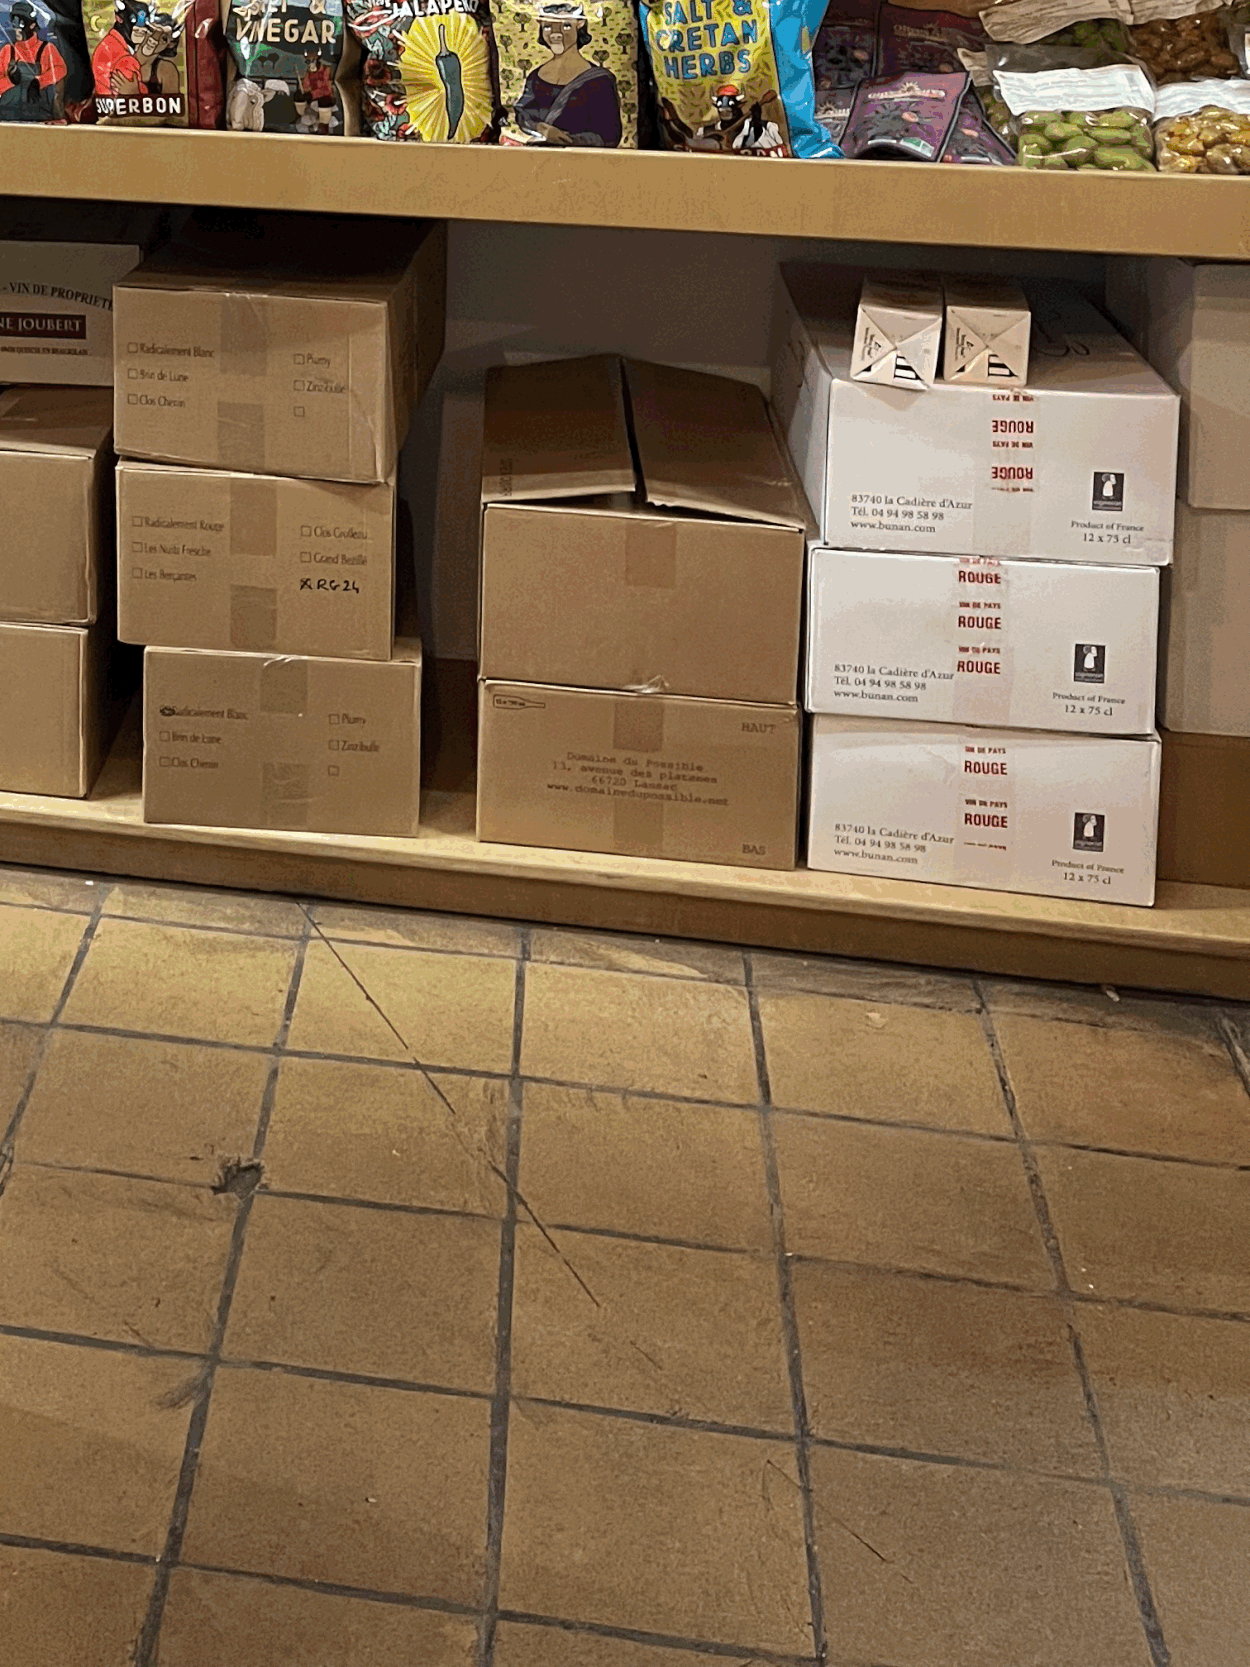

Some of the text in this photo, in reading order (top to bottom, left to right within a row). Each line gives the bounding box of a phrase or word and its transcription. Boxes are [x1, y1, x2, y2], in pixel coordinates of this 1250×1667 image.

[235, 20, 336, 44] VINEGAR
[656, 20, 758, 51] CRETAN
[663, 50, 751, 80] HERBS
[96, 96, 182, 115] SUPERBON
[9, 281, 30, 294] VIN
[32, 283, 48, 295] DE
[17, 314, 83, 335] JOUBERT
[139, 343, 215, 359] Radicalement Blanc
[139, 394, 156, 407] Clos
[991, 420, 1034, 434] ROUGE
[990, 466, 1033, 480] ROUGE
[850, 494, 973, 510] 83740 la Cadière d'Azur
[851, 506, 944, 522] Tél. 04 94 98 58 98
[144, 516, 225, 533] Radicalement Rouge
[850, 520, 936, 534] www.bunan.com
[1070, 520, 1145, 533] Product France
[1083, 532, 1131, 545] 12 75 cl
[144, 542, 157, 555] Les
[958, 570, 1001, 585] ROUGE
[957, 615, 1002, 630] ROUGE
[834, 663, 955, 681] 83740 la Cadière d'Azur
[957, 660, 1001, 675] ROUGE
[834, 689, 919, 704] www.bunan.com
[1064, 705, 1113, 717] 12 75 cl
[741, 722, 777, 735] HAUT
[567, 751, 704, 772] Domaine du Possible
[963, 760, 1008, 776] ROUGE
[580, 765, 718, 784] avenue des platanes
[964, 812, 1008, 829] ROUGE
[879, 825, 955, 845] Cadière d'Azur
[742, 844, 766, 856] BAS
[834, 848, 919, 865] www.bunan.com
[1063, 871, 1100, 884] 12 75
